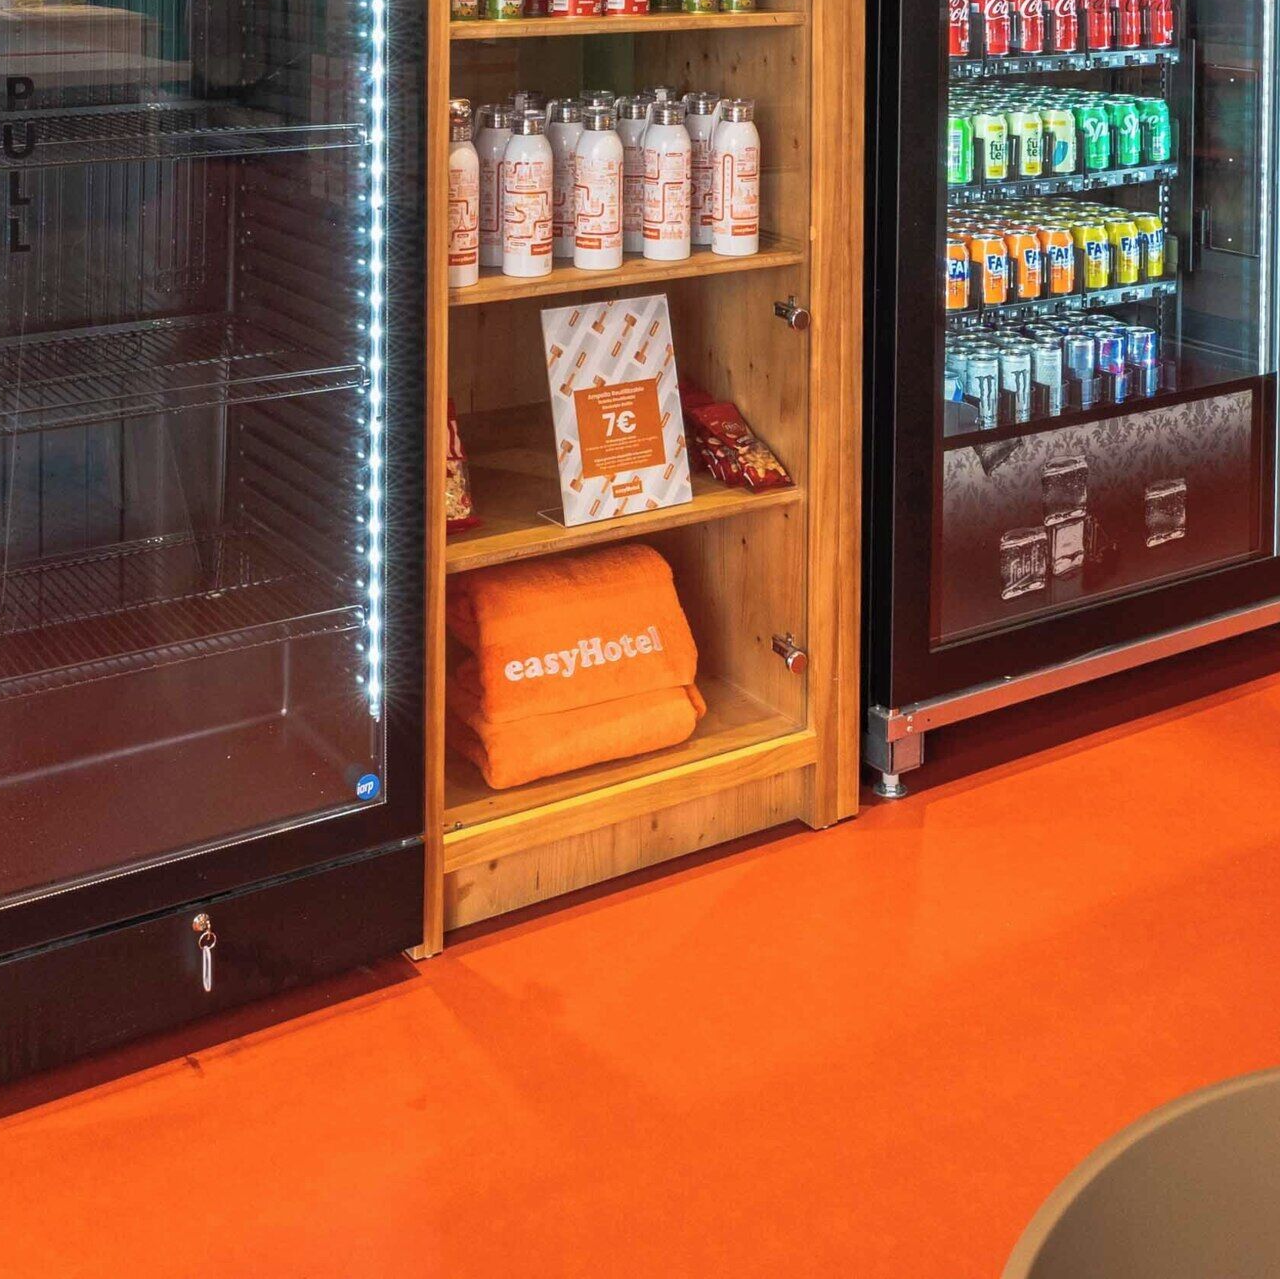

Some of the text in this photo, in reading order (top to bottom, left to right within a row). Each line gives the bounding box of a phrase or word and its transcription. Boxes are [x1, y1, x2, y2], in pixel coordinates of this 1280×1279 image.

[2, 76, 36, 253] PULL
[602, 410, 637, 437] 7€
[503, 625, 664, 682] easyHotel
